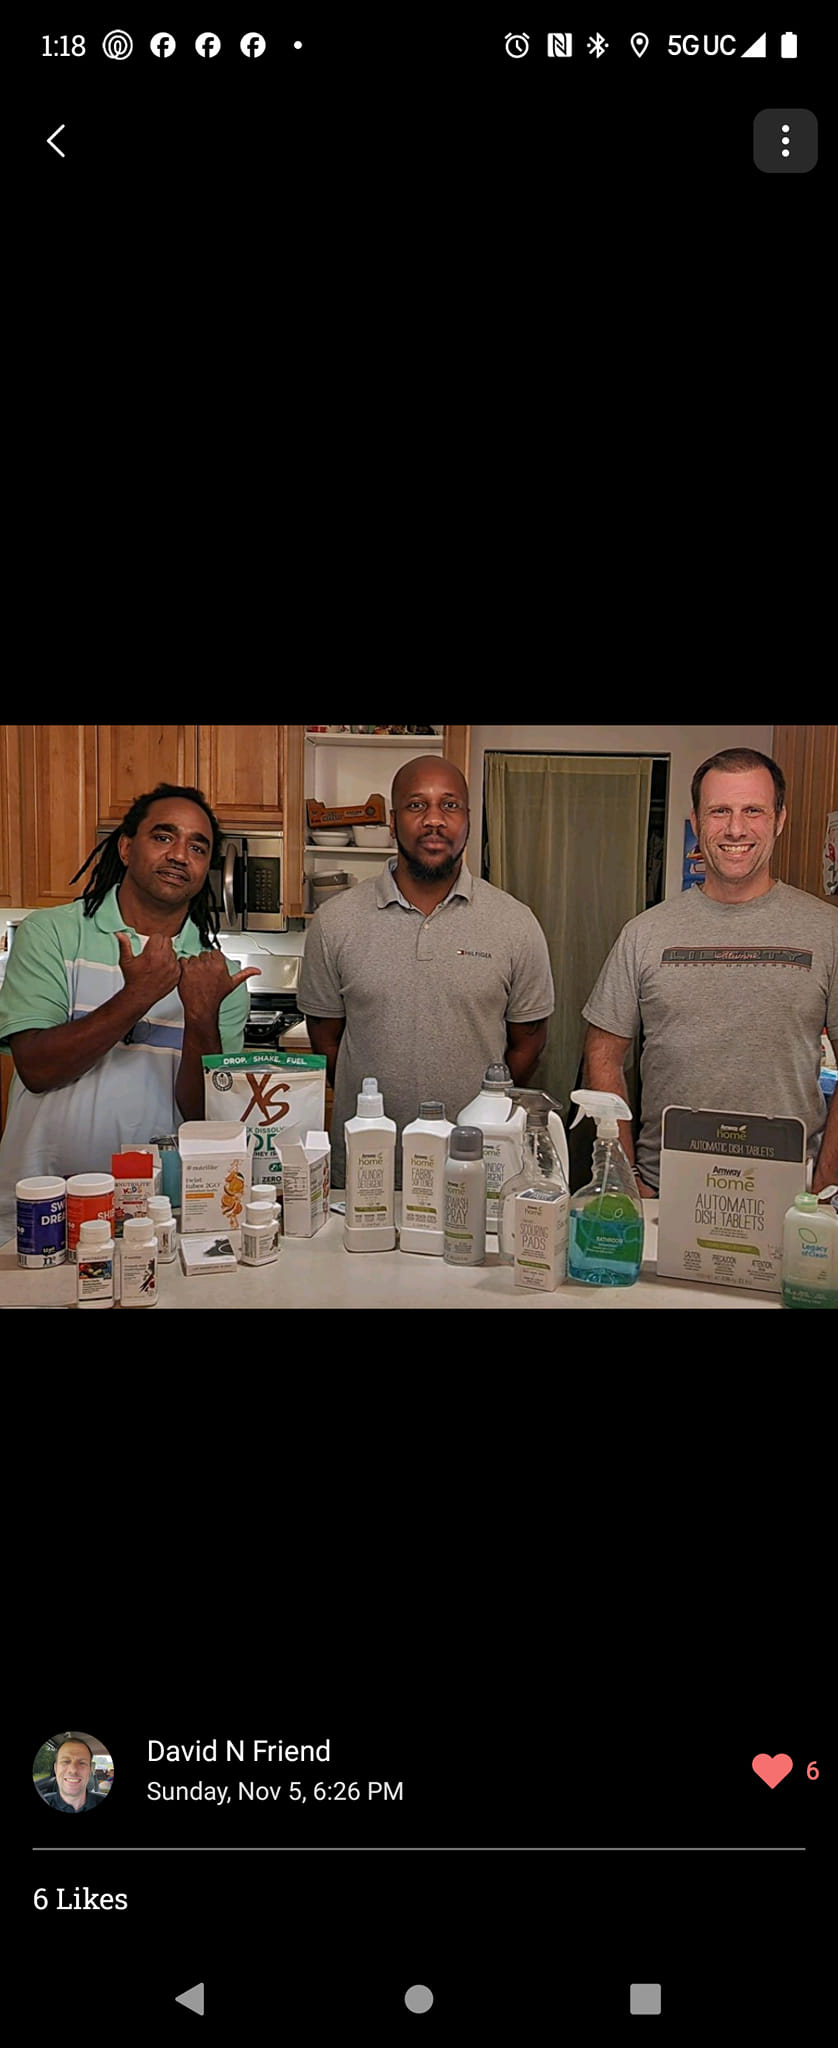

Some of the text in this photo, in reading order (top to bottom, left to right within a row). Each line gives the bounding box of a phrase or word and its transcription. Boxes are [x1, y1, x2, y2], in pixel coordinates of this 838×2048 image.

[223, 1057, 248, 1065] DROP.
[240, 1073, 290, 1126] XS
[716, 1128, 747, 1140] home
[690, 1139, 775, 1157] AUTOMATIC DISH TABLETS
[712, 1166, 741, 1177] Amway
[706, 1173, 755, 1192] home
[695, 1193, 765, 1216] AUTOMATIC
[694, 1208, 765, 1231] DISH TABLETS
[522, 1235, 546, 1250] PADS
[801, 1243, 829, 1253] Legacy
